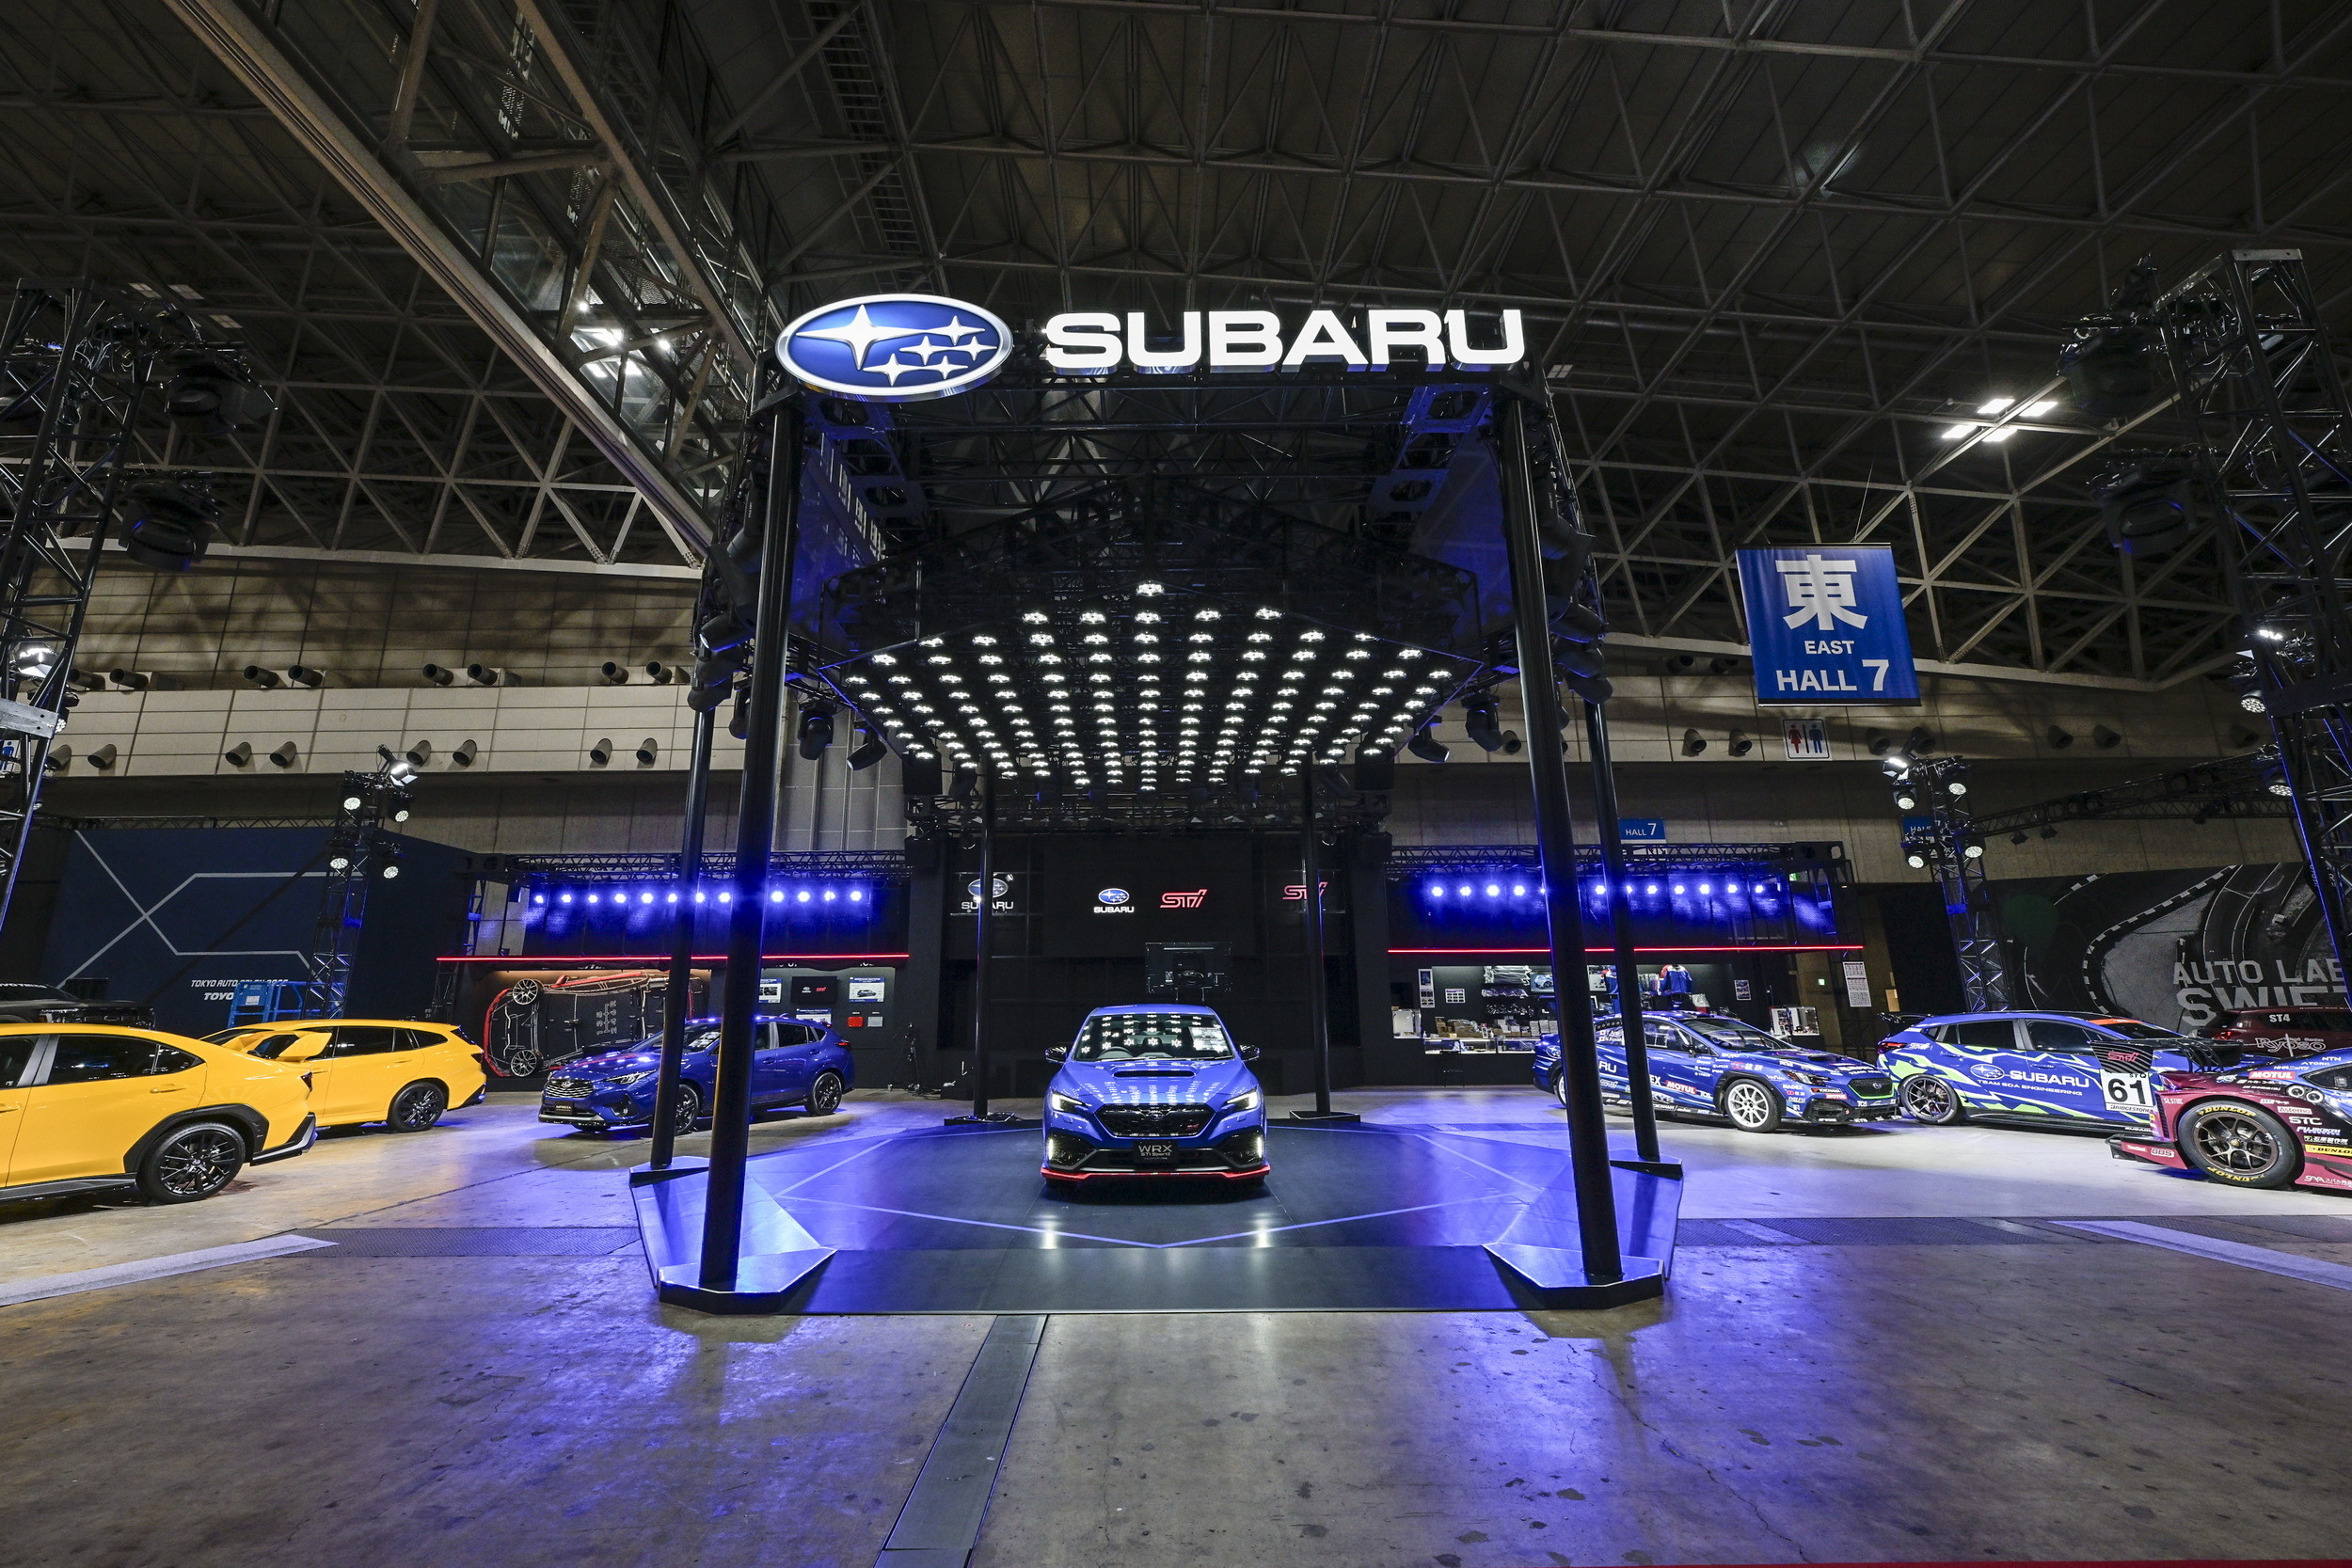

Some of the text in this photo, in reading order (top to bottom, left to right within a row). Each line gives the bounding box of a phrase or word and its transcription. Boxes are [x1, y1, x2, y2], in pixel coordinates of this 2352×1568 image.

[1045, 309, 1526, 372] SUBARU
[1775, 554, 1868, 630] 東
[1804, 640, 1855, 655] EAST
[1775, 659, 1890, 691] HALL 7
[1647, 823, 1657, 836] 7
[2173, 959, 2264, 985] AUTO
[191, 979, 216, 988] TOKYO
[216, 979, 239, 988] AUTO
[2269, 1014, 2291, 1022] ST4
[2010, 1070, 2090, 1088] SUBARU
[1666, 1082, 1696, 1094] MOTUL
[2022, 1085, 2083, 1096] ENGINEERING
[2108, 1078, 2146, 1105] 61
[2111, 1104, 2150, 1113] BRIDGESTONE
[2204, 1106, 2256, 1117] DUNLOP
[2289, 1117, 2322, 1125] STC
